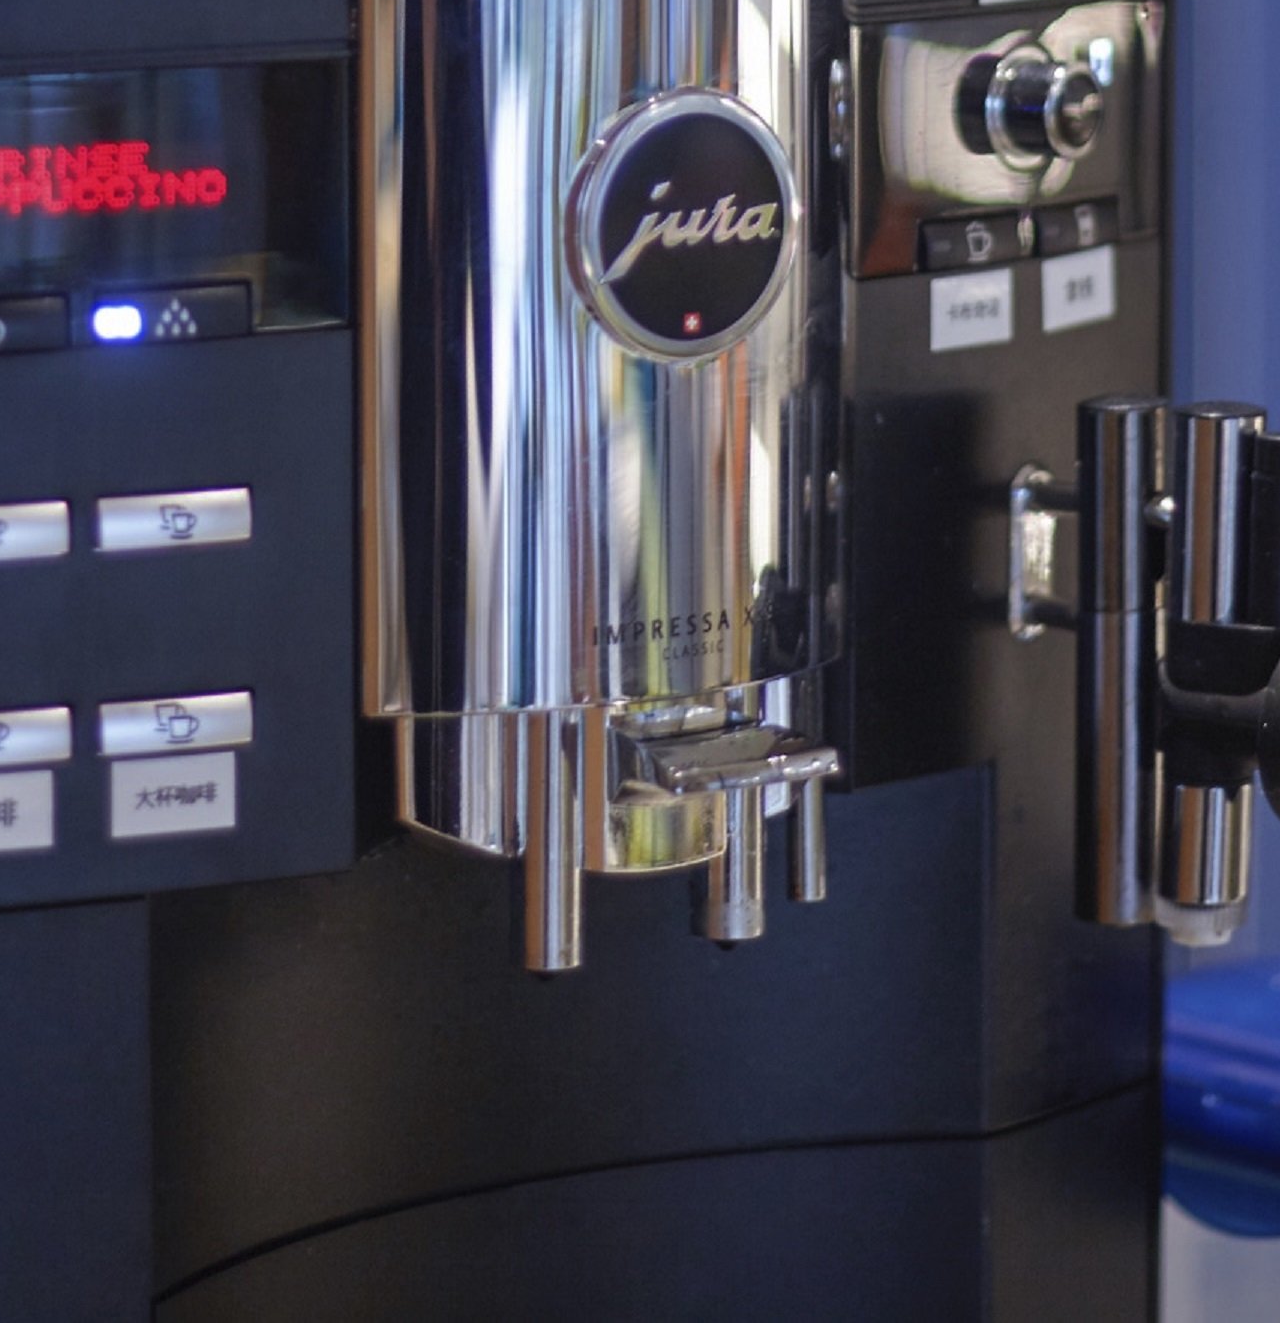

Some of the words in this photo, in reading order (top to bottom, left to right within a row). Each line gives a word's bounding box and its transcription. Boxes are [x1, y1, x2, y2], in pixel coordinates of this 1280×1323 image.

[600, 181, 777, 284] jura
[593, 609, 730, 646] IMPRESSA
[662, 638, 725, 661] CLASSIC
[135, 781, 218, 812] 大杯咖啡
